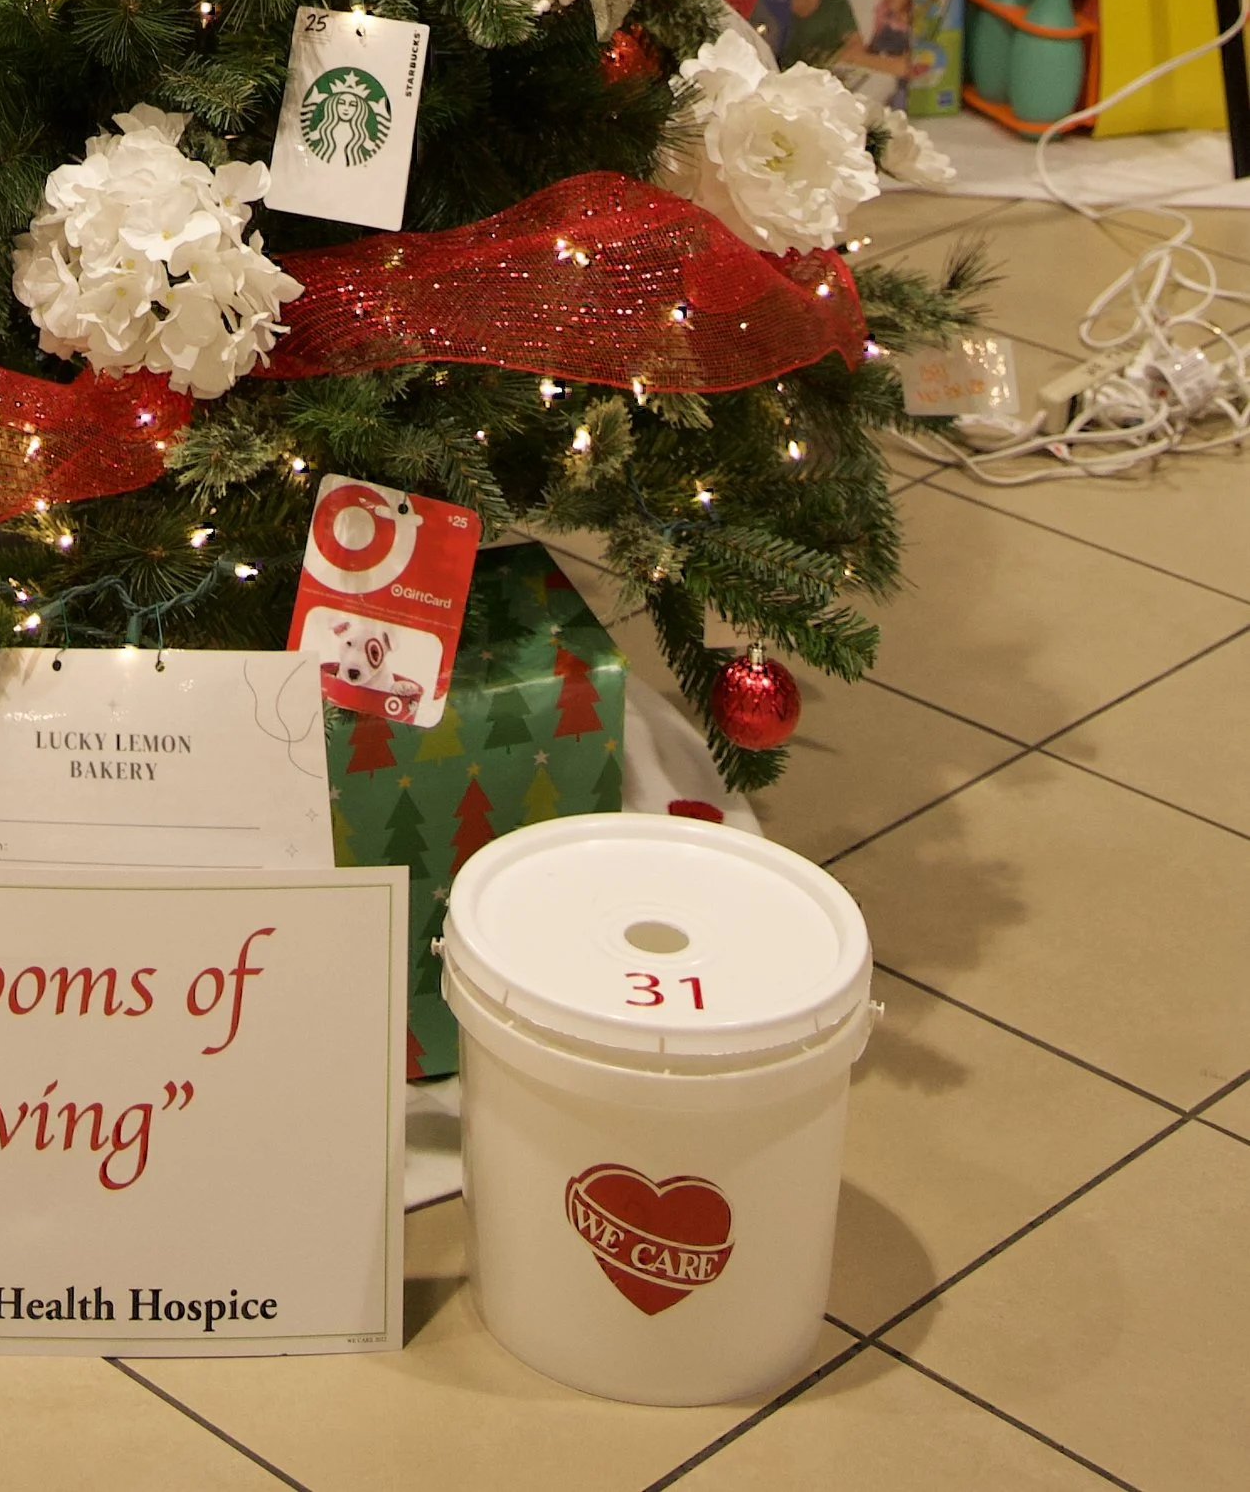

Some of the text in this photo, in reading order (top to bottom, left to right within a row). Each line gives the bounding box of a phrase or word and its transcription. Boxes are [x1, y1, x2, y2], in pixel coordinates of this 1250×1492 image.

[304, 13, 329, 32] 25
[405, 31, 421, 98] STARBUCKS
[447, 515, 468, 529] $25
[402, 586, 452, 609] GiftCard
[36, 730, 193, 755] LUCKY LEMON
[69, 760, 159, 782] BAKERY
[186, 927, 276, 1056] of
[624, 971, 706, 1012] 31
[573, 1199, 719, 1282] WE CARE
[128, 1286, 279, 1332] Hospice
